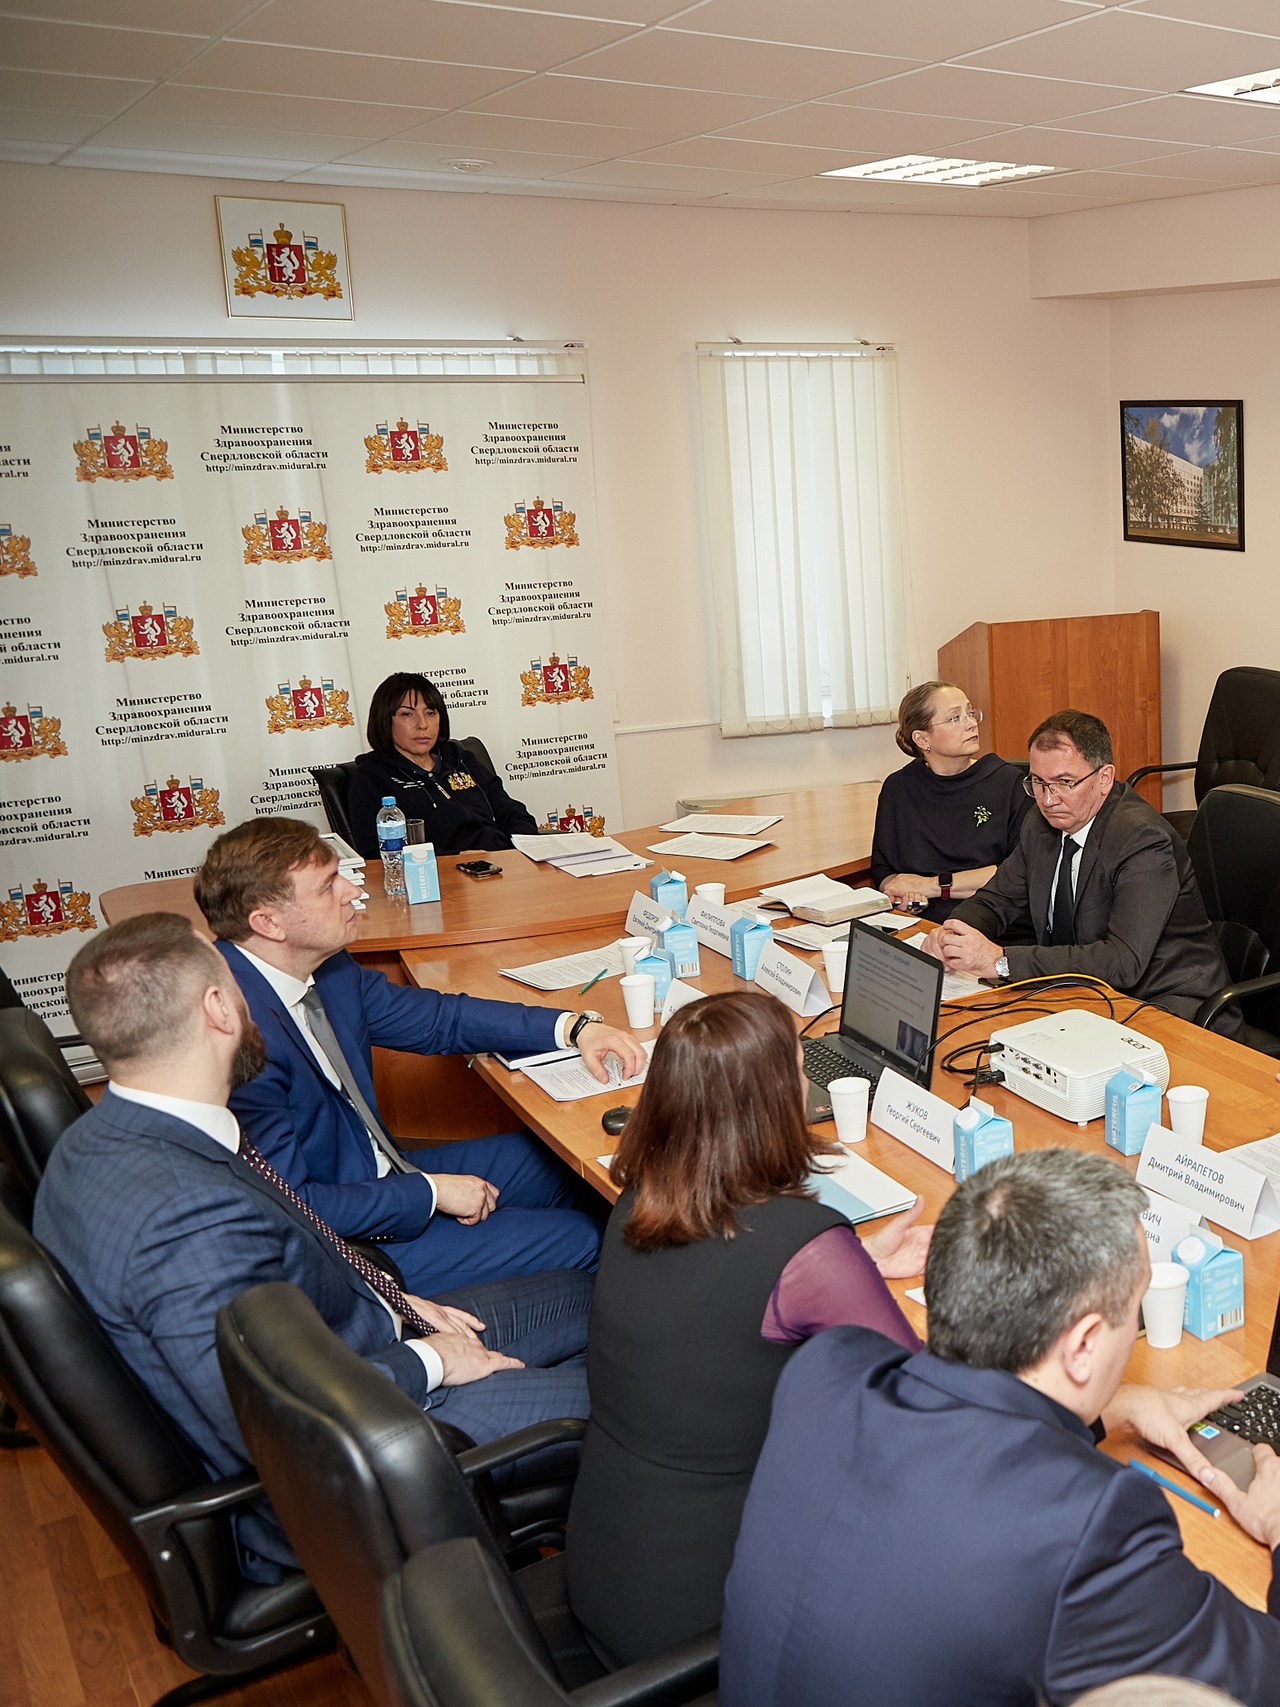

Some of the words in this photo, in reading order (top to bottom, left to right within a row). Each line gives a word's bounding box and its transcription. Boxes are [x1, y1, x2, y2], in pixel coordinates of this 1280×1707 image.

[221, 426, 303, 435] Министерство
[489, 422, 558, 431] Министерство
[214, 439, 312, 449] Здравоохранения
[483, 434, 566, 444] Здравоохранения
[201, 451, 282, 462] Свердловской
[285, 450, 328, 458] области
[471, 445, 539, 456] Свердловской
[206, 462, 326, 473] http://minzdrav.midural.ru
[475, 456, 577, 466] http://minzdrav.midural.ru
[374, 508, 448, 516] Министерство
[88, 519, 175, 528] Министерство
[368, 519, 456, 530] Здравоохранения
[80, 531, 186, 544] Здравоохранения
[356, 530, 429, 543] Свердловской
[432, 529, 471, 537] области
[66, 544, 153, 557] Свердловской
[157, 543, 203, 551] области
[360, 540, 469, 553] http://minzdrav.midural.ru
[72, 555, 201, 569] http://minzdrav.midural.ru
[505, 581, 573, 590] Министерство
[245, 598, 325, 608] Министерство
[499, 592, 580, 604] Здравоохранения
[238, 609, 334, 623] Здравоохранения
[488, 603, 555, 616] Свердловской
[558, 602, 593, 610] области
[492, 612, 591, 626] http://minzdrav.midural.ru
[226, 622, 305, 636] Свердловской
[308, 620, 350, 629] области
[231, 631, 348, 647] http://minzdrav.midural.ru
[11, 641, 61, 652] области
[116, 693, 201, 707] Министерство
[450, 688, 489, 698] области
[109, 705, 211, 722] Здравоохранения
[96, 719, 180, 735] Свердловской
[184, 716, 228, 726] области
[101, 727, 226, 746] http://minzdrav.midural.ru
[522, 734, 587, 746] Министерство
[516, 744, 594, 759] Здравоохранения
[505, 756, 571, 771] Свердловской
[573, 753, 607, 762] области
[509, 764, 605, 781] http://minzdrav.midural.ru
[0, 795, 62, 808] истерство
[250, 789, 321, 804] Свердловско
[0, 807, 72, 822] оохранения
[41, 818, 91, 831] области
[0, 830, 89, 847] nzdrav.midural.ru
[1120, 1036, 1151, 1051] acer
[905, 1100, 929, 1121] ЖУКОВ
[886, 1104, 910, 1125] Георгий
[910, 1118, 941, 1145] Сергеевич
[1111, 1094, 1119, 1145] WATERFUL
[1175, 1154, 1224, 1184] АЙРАПЕТОВ
[1148, 1157, 1183, 1181] Дмитрий
[1184, 1174, 1244, 1212] Владимирович
[1142, 1208, 1162, 1227] ВИЧ
